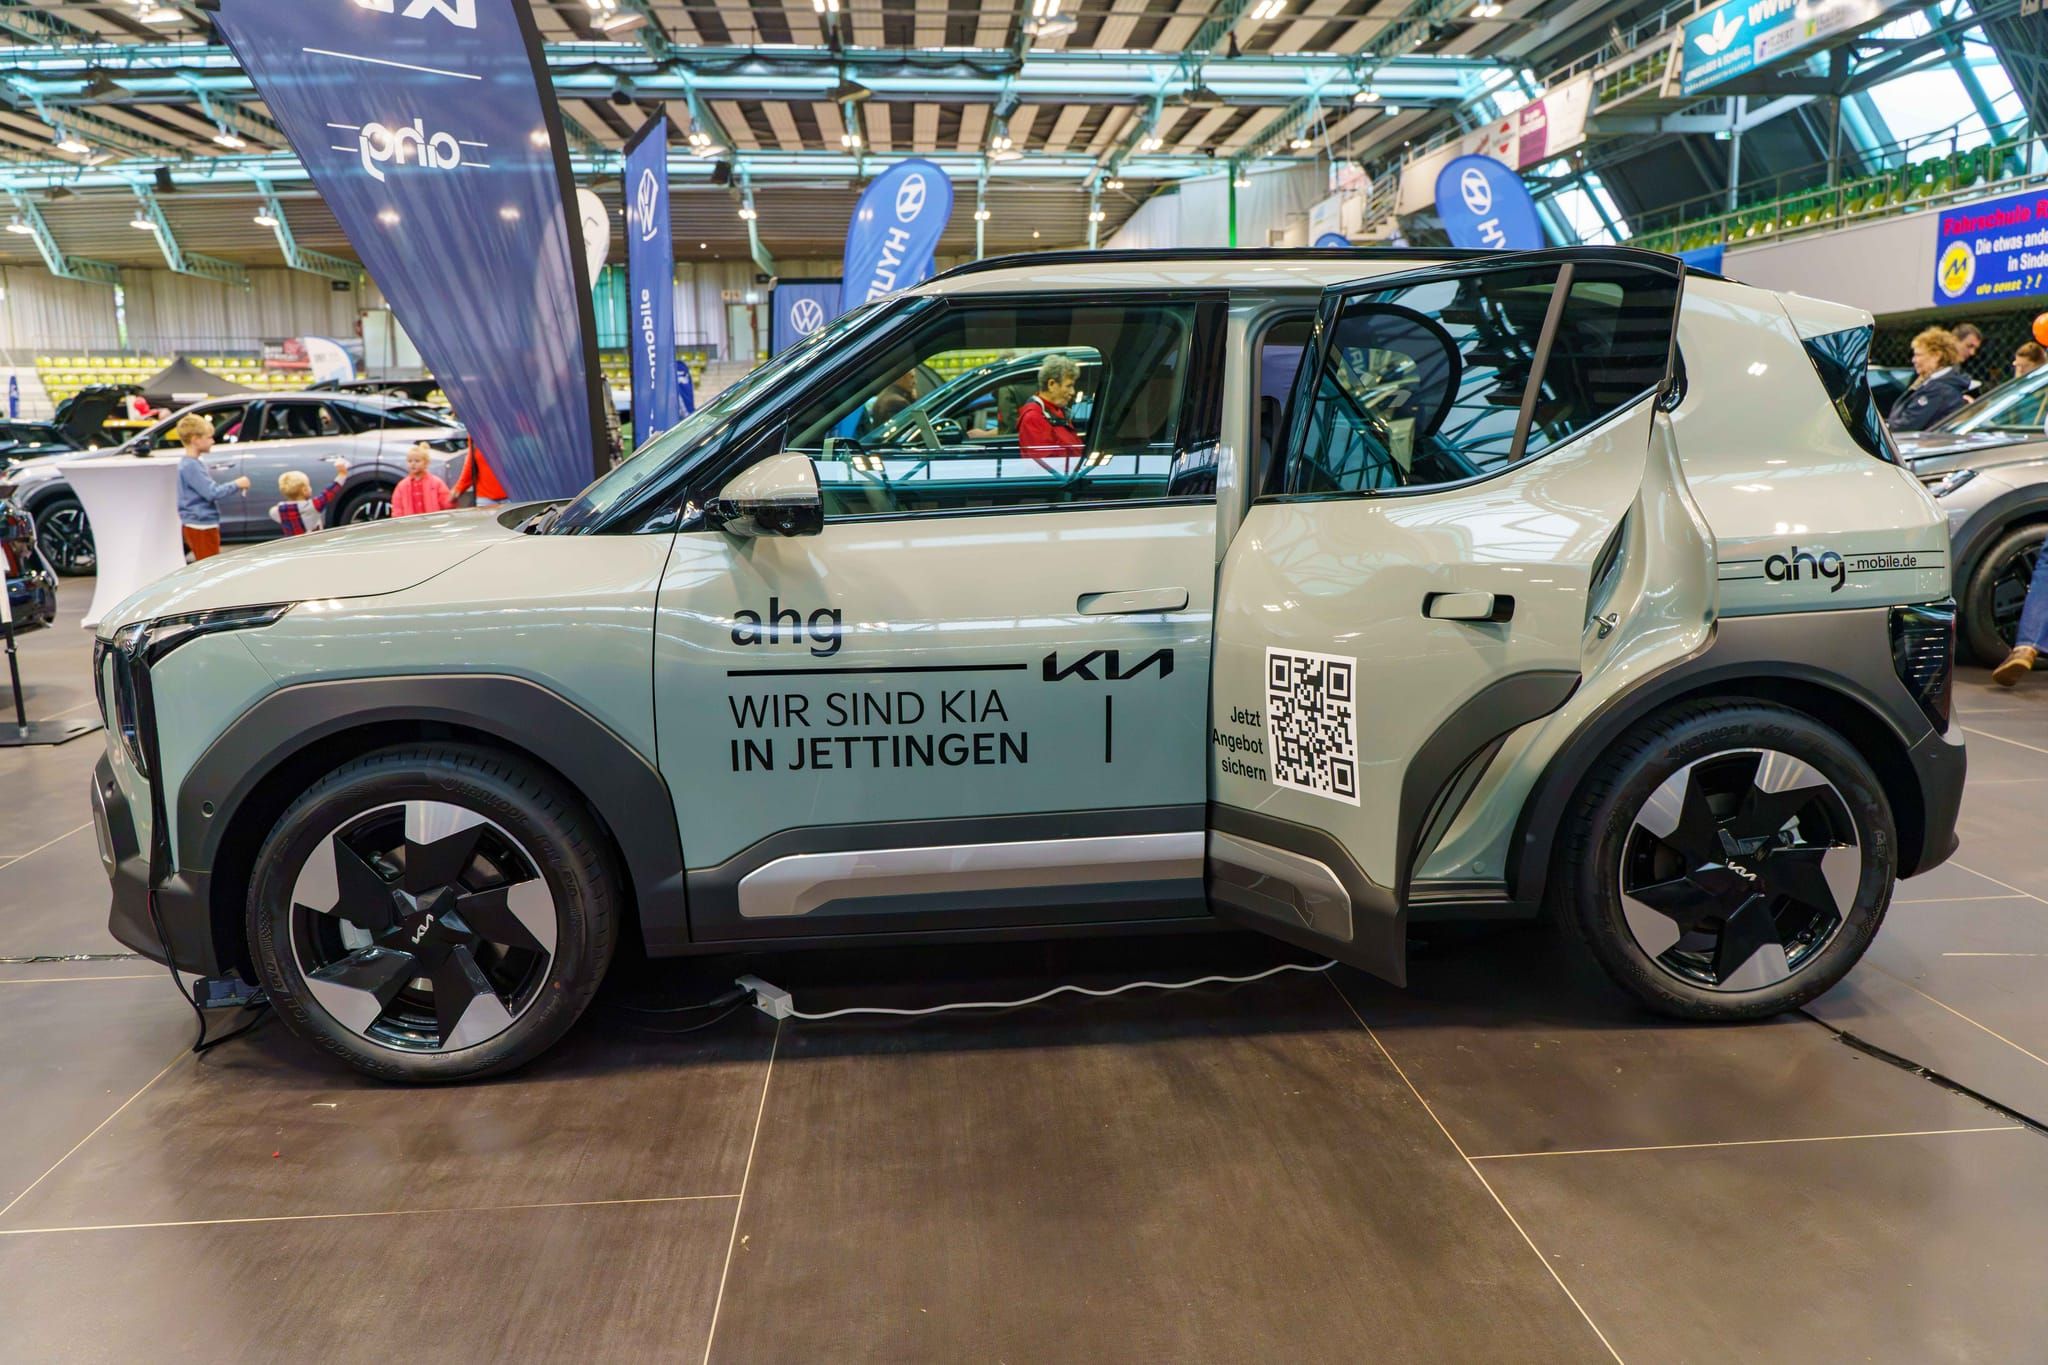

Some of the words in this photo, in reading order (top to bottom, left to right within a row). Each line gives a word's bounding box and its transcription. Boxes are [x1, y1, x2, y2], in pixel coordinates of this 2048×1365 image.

[1943, 204, 2032, 237] Fahrschule
[1975, 238, 1992, 256] Die
[1993, 235, 2023, 253] etwas
[2007, 255, 2019, 272] in
[1765, 546, 1846, 593] ahg
[731, 597, 842, 657] ahg
[1043, 648, 1175, 681] KIA
[728, 694, 811, 729] WIR
[826, 691, 925, 727] SIND
[941, 689, 1009, 724] KIA
[1230, 706, 1262, 727] Jetzt
[731, 738, 774, 772] IN
[788, 732, 1028, 771] JETTINGEN
[1212, 728, 1264, 754] Angebot
[1221, 757, 1267, 781] sichern
